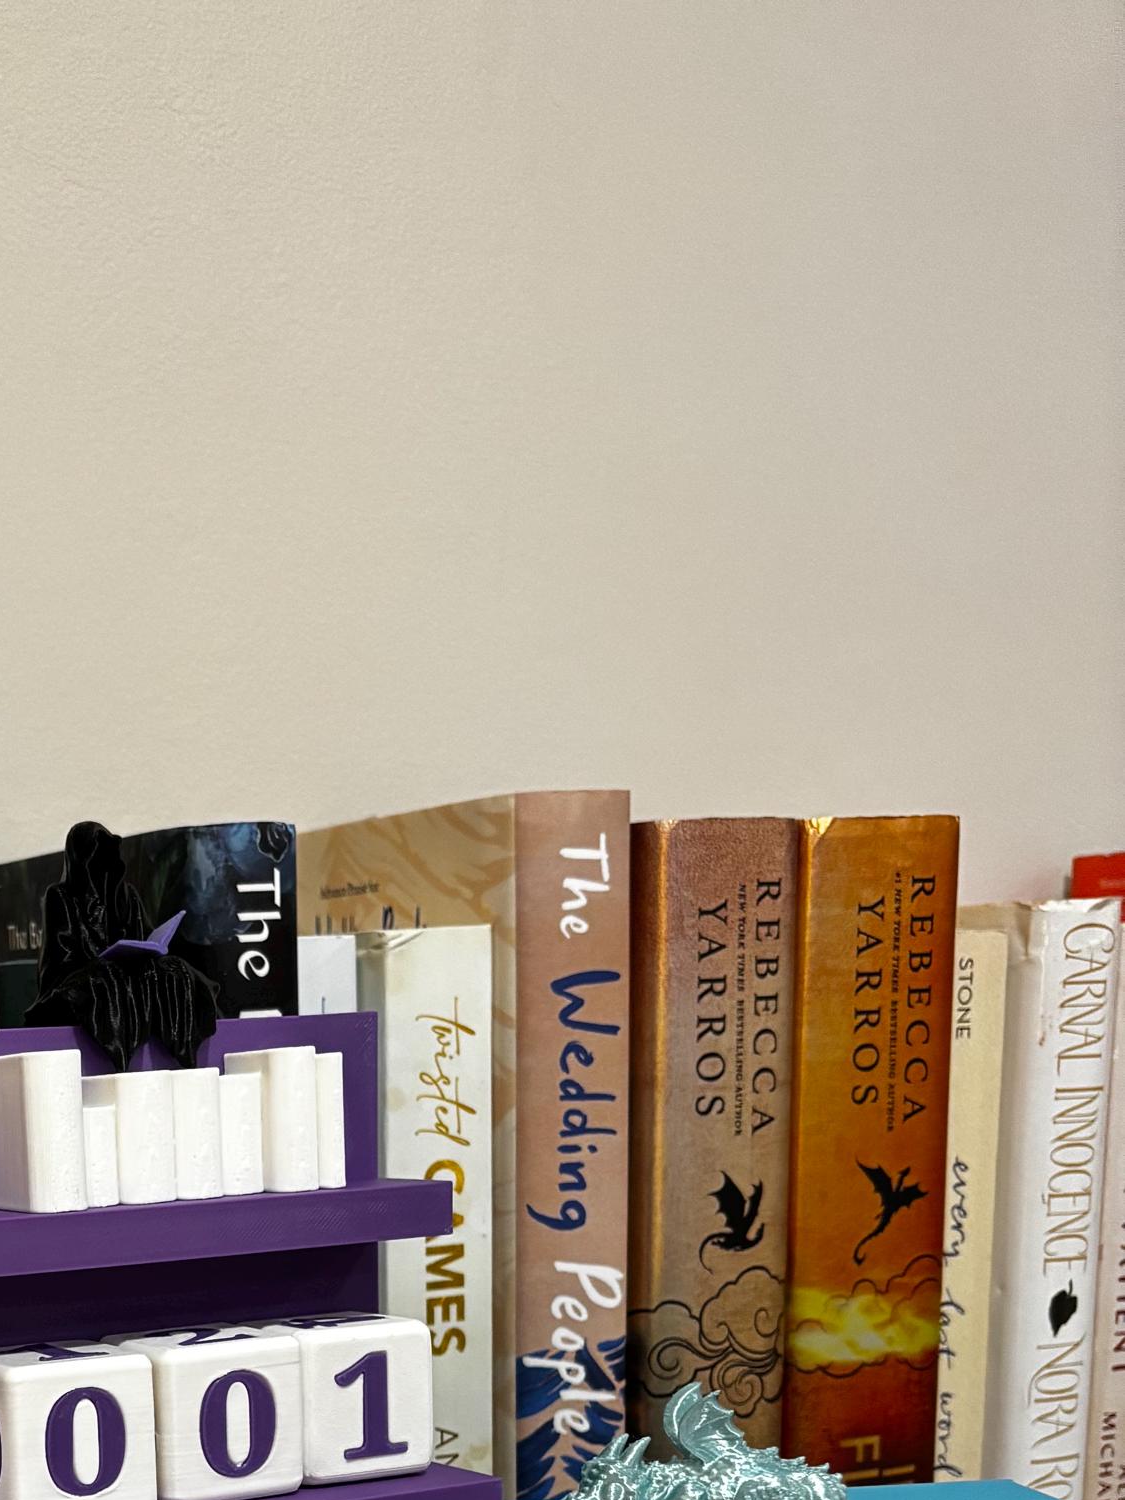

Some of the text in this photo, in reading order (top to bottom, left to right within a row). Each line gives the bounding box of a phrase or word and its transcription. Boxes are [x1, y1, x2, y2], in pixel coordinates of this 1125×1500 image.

[236, 867, 282, 981] The
[695, 899, 728, 1117] YARROS
[751, 878, 782, 1135] REBECCA
[851, 896, 885, 1105] YARROS
[902, 876, 936, 1124] REBECCA
[956, 957, 974, 1039] STONE
[1057, 922, 1115, 1076] CARNAL
[415, 996, 476, 1357] twisted GMES
[523, 833, 623, 1435] The Wedding People
[1043, 1086, 1104, 1277] INNOCENCE
[934, 1157, 968, 1478] every last word
[1028, 1332, 1085, 1449] NORA
